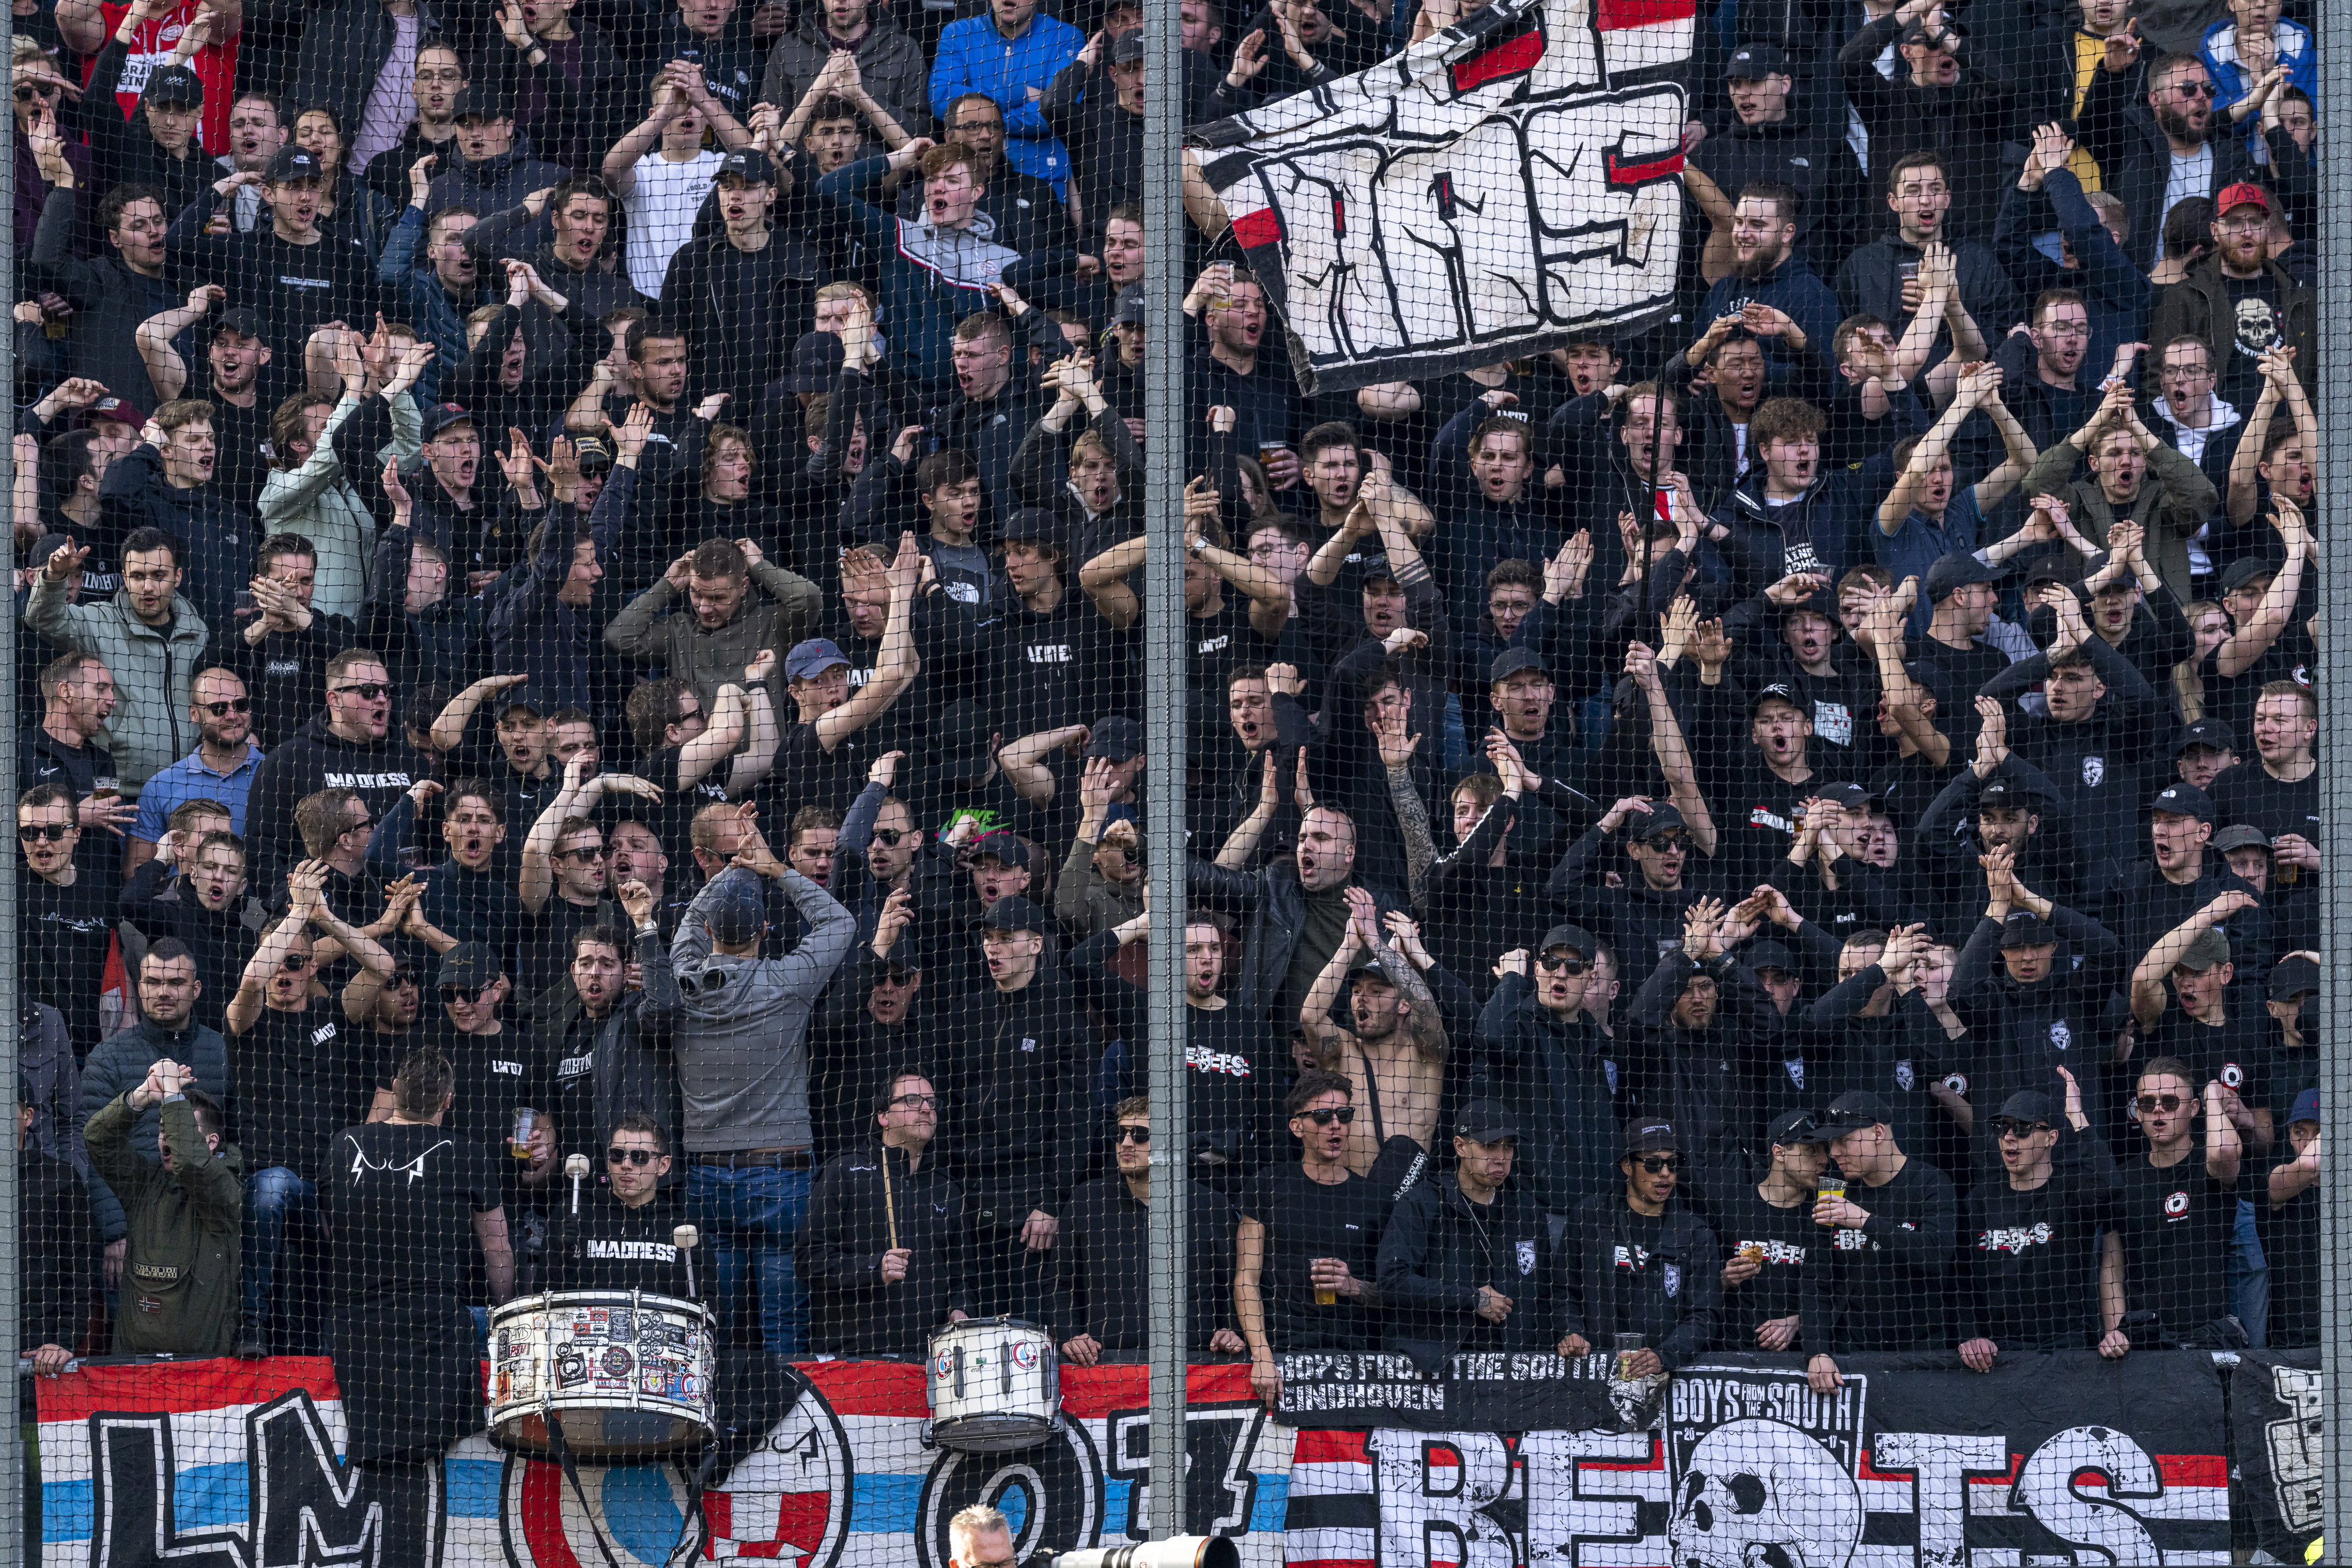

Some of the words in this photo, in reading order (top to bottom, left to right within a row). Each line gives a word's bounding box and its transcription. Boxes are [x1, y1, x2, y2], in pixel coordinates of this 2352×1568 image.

[328, 773, 412, 789] MADNESS
[493, 1059, 523, 1076] LM'07
[593, 1239, 677, 1263] MADNESS
[1452, 1352, 1506, 1381] THE
[1279, 1383, 1445, 1412] EINDHOVEN
[1672, 1378, 1740, 1424] BOYS
[1741, 1383, 1766, 1401] FROM
[1745, 1401, 1761, 1417] THE
[1766, 1382, 1851, 1431] SOUTH
[1684, 1427, 1695, 1441] 20
[1829, 1435, 1838, 1449] 17
